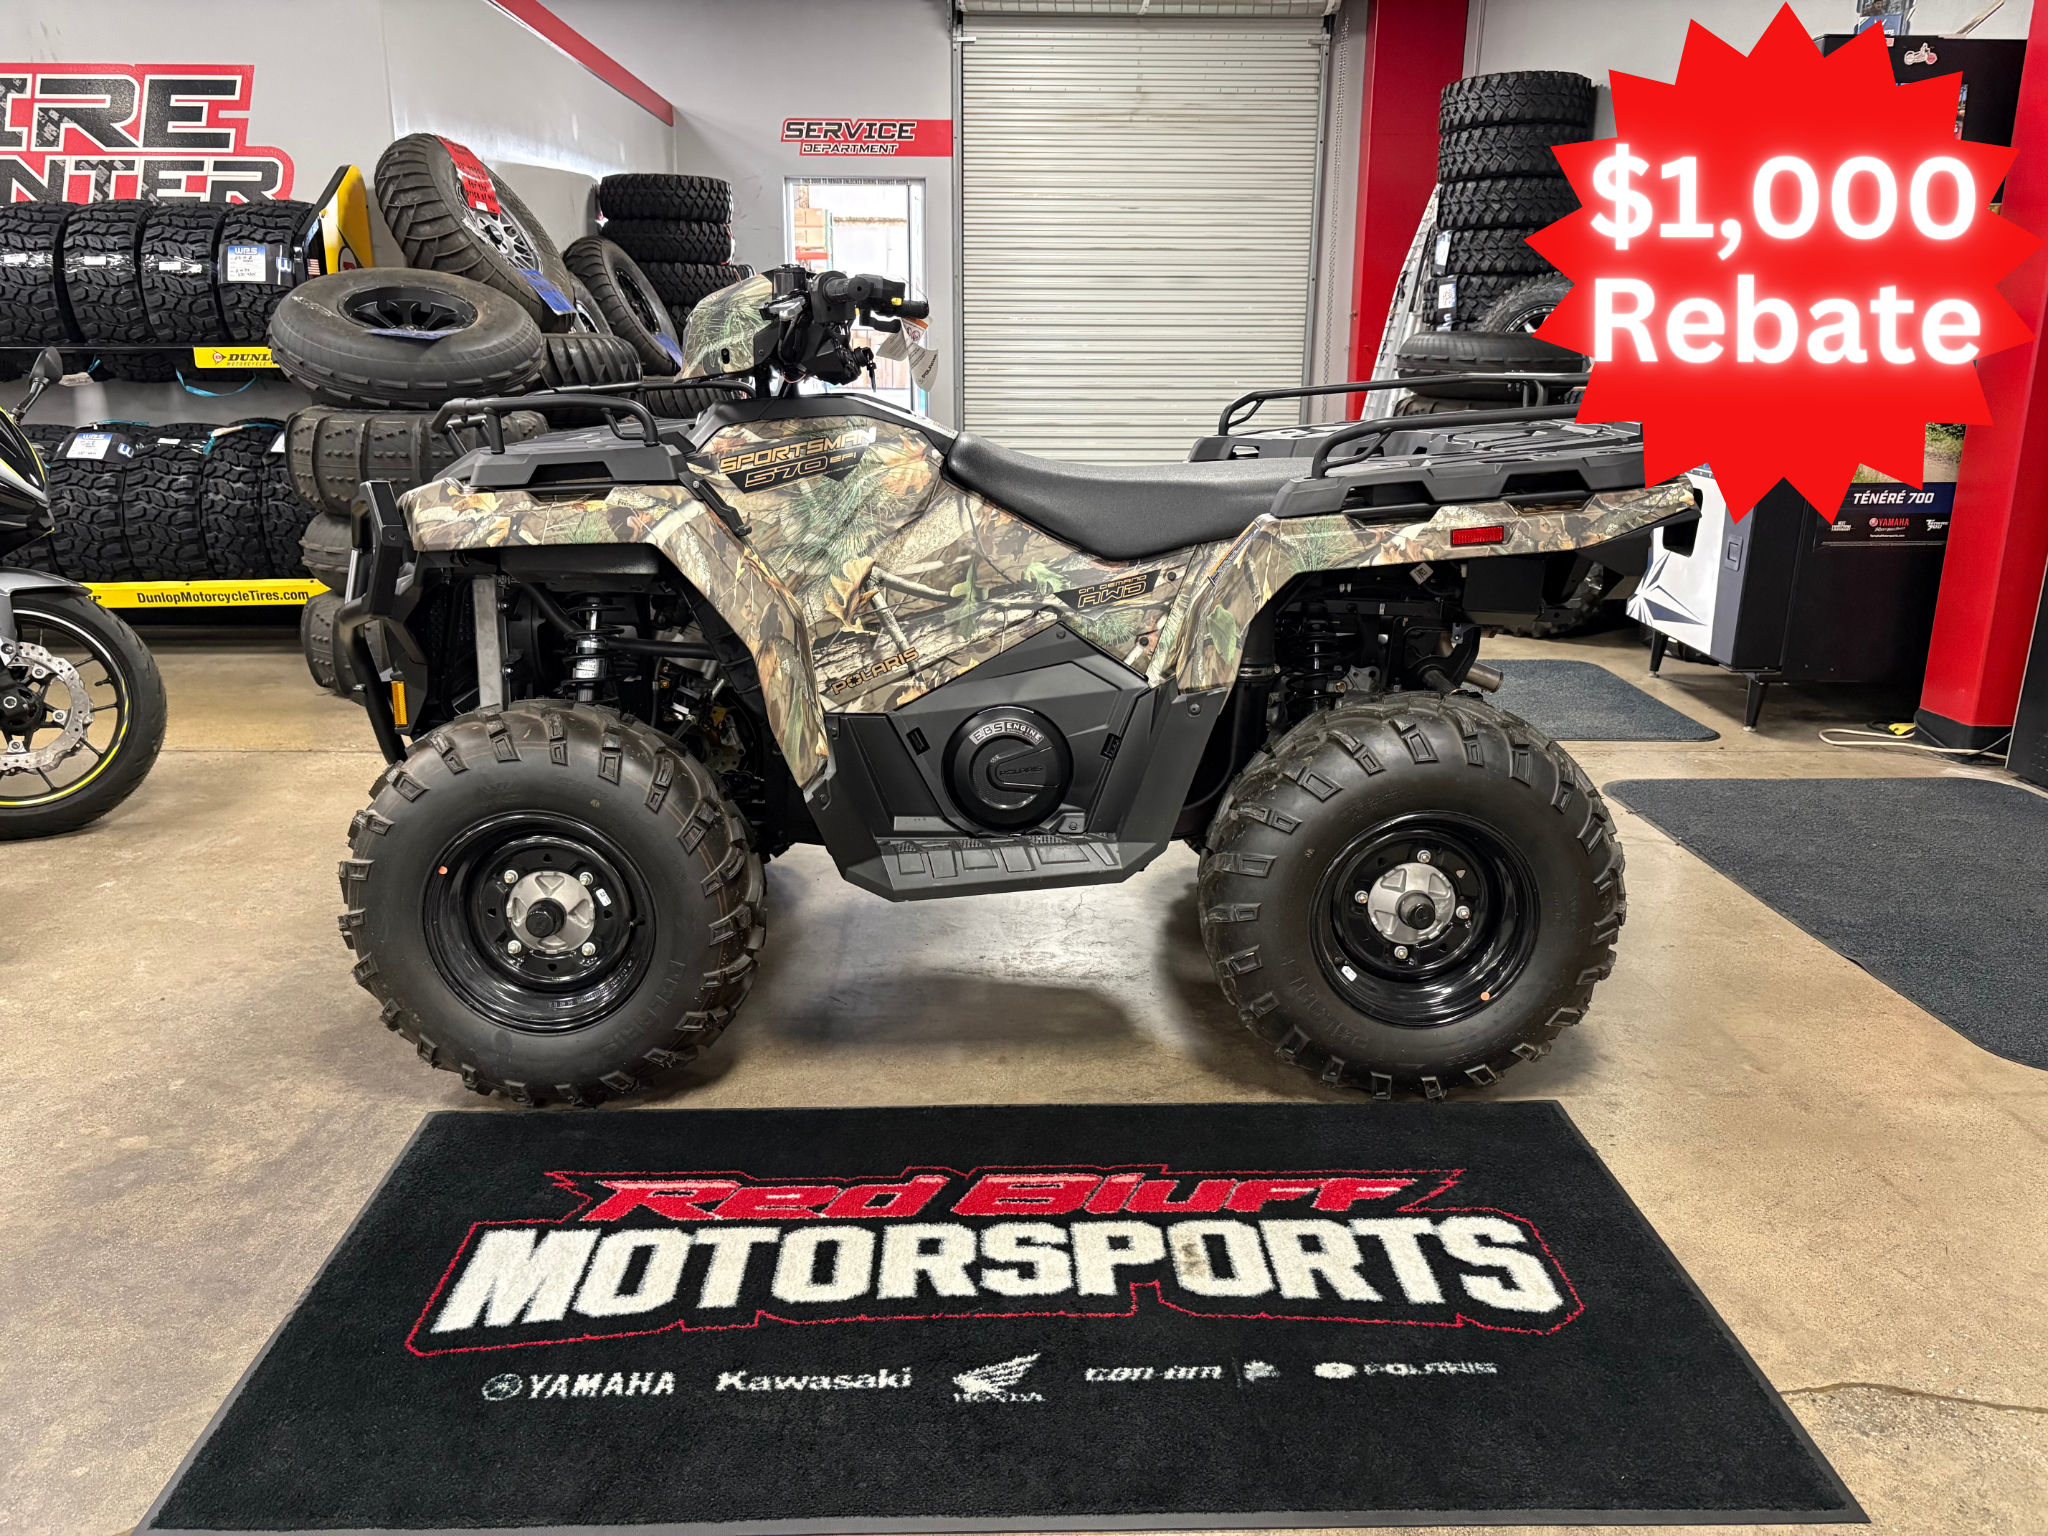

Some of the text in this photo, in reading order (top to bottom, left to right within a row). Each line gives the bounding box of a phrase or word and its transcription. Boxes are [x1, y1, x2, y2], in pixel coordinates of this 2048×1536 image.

[784, 121, 916, 140] SERVICE
[803, 143, 898, 154] DEPARTMENT
[234, 247, 258, 255] WPS
[227, 353, 270, 361] DUNL
[719, 427, 877, 474] SPORTSMAN
[745, 452, 857, 488] 570 EFI
[1853, 490, 1935, 505] TÉNÉRÉ 700
[1879, 518, 1910, 526] YAMAHA
[136, 590, 309, 605] DunlopMotorcycleTires.com
[1077, 581, 1147, 608] AWD
[831, 647, 919, 695] POLARIS
[973, 722, 1003, 742] EBS
[1006, 722, 1042, 741] ENGINE
[999, 766, 1043, 776] POLARIS
[579, 1172, 1418, 1221] Red Bluff
[430, 1216, 1563, 1334] MOTORSPORTS
[529, 1372, 676, 1399] YAMAHA
[715, 1367, 911, 1392] Kawasaki
